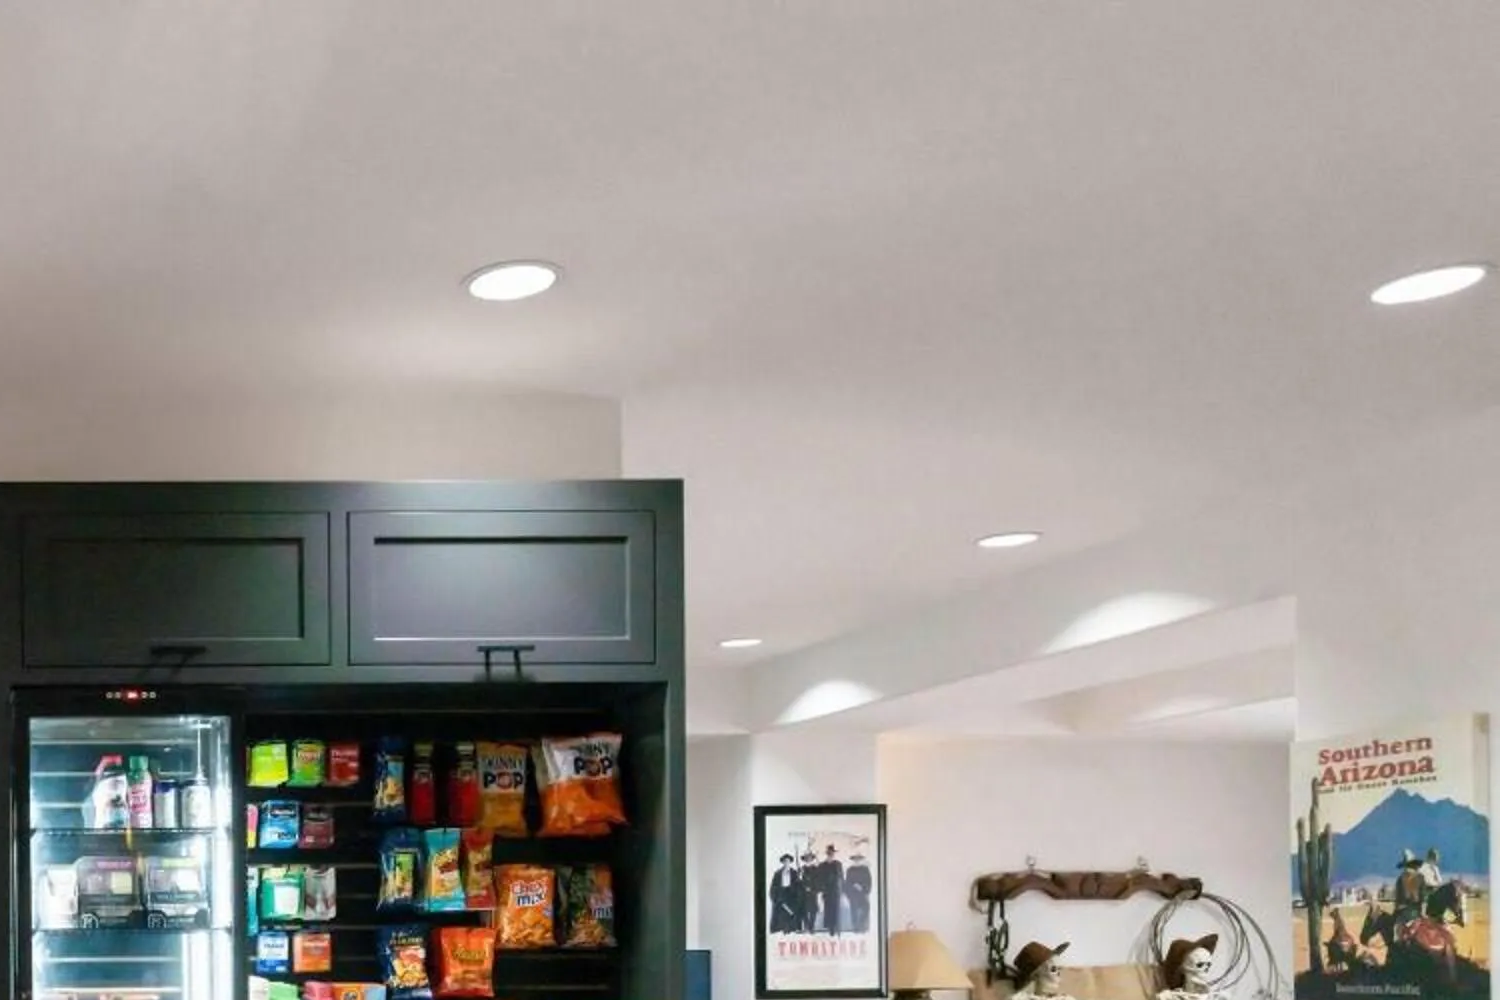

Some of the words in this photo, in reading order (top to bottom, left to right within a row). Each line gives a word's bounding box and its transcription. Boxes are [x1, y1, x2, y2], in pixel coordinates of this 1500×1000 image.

[1318, 737, 1432, 765] Southern
[574, 756, 612, 775] POP
[1318, 756, 1436, 787] Arizona
[483, 772, 524, 789] POP
